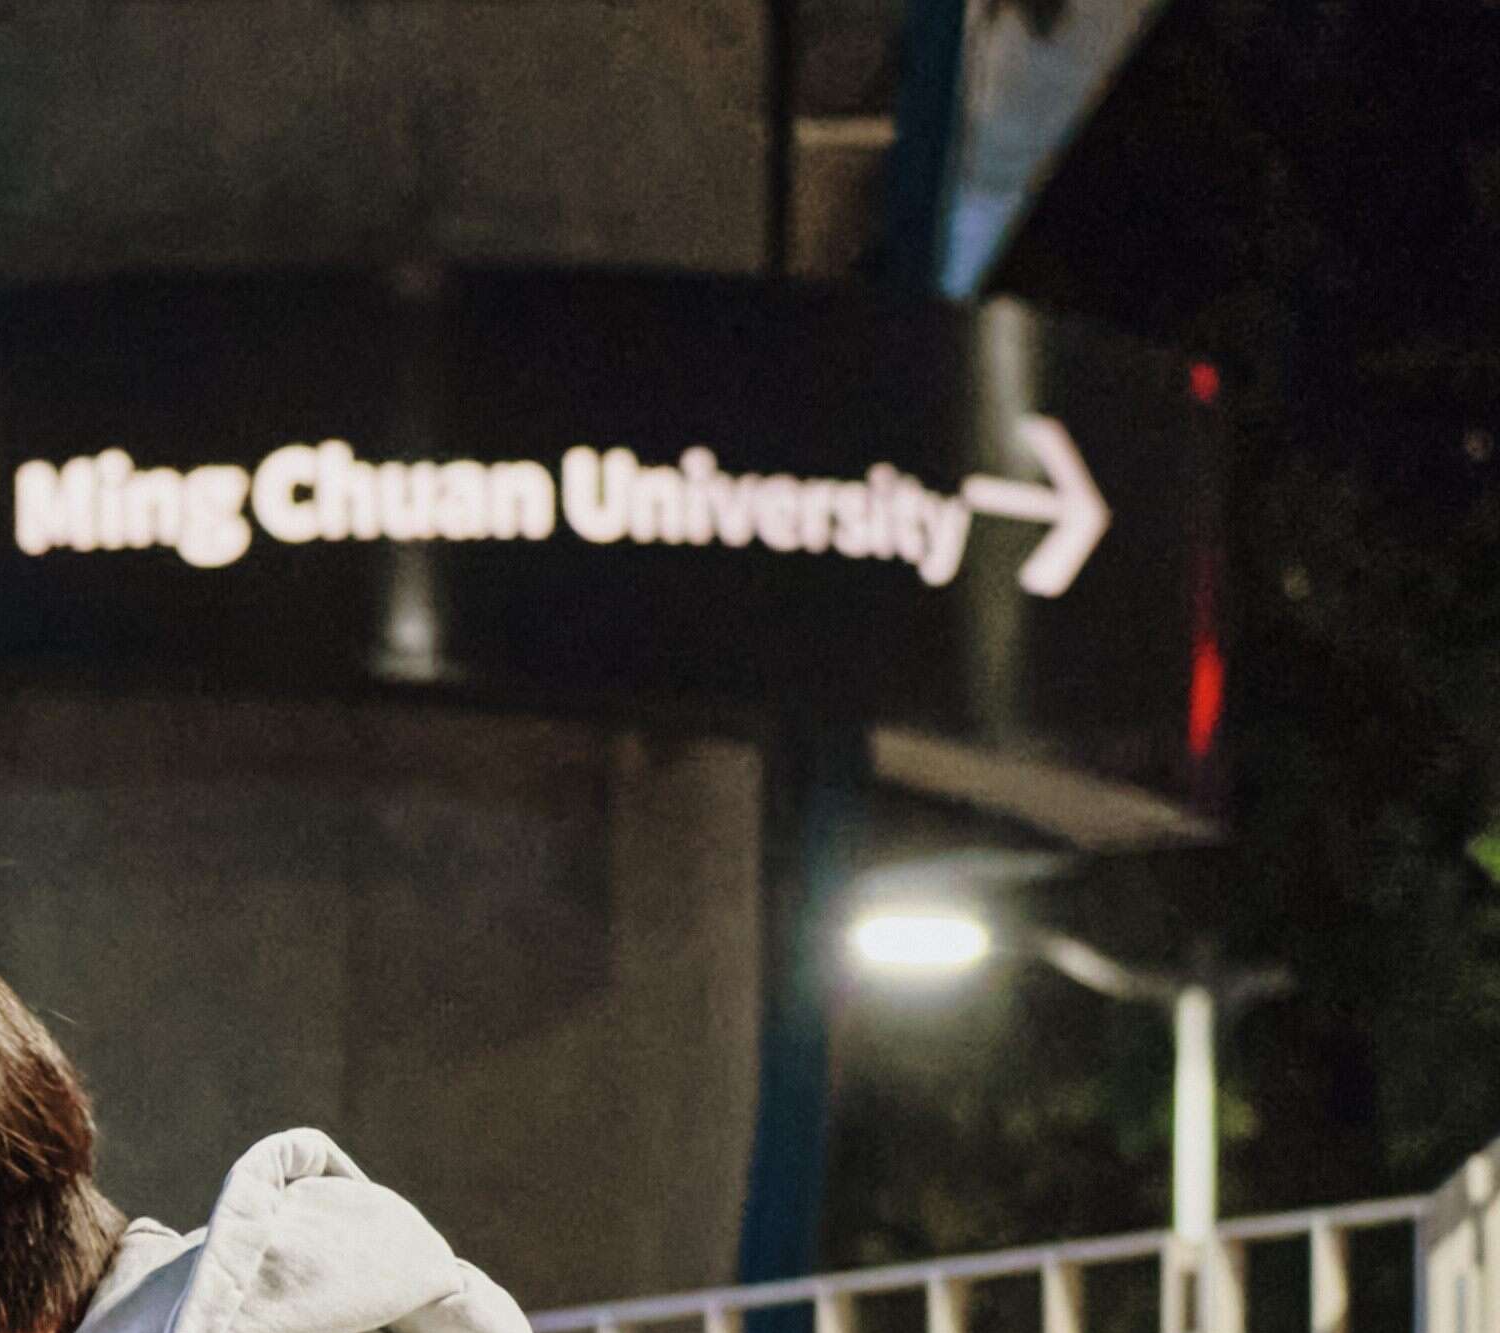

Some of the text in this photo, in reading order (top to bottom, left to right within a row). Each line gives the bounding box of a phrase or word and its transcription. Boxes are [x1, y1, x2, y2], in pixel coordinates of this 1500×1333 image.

[14, 438, 972, 586] Ming Chuan University
